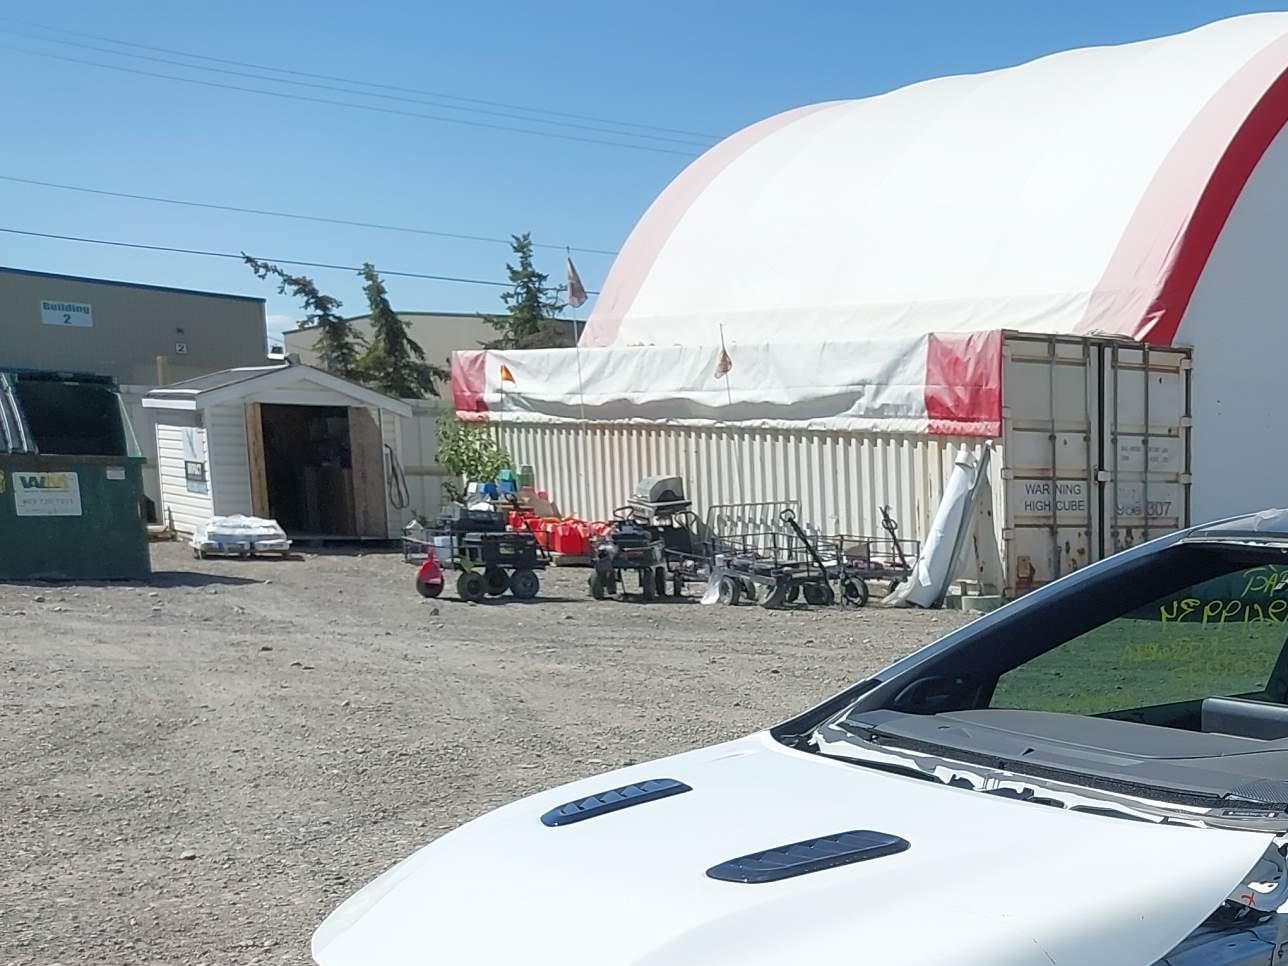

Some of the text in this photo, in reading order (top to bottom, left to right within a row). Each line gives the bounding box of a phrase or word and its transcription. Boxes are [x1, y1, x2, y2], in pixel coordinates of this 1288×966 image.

[43, 302, 90, 314] Building
[64, 313, 73, 325] 2
[1025, 484, 1082, 496] WARNING
[1024, 501, 1086, 512] HIGH CUBE
